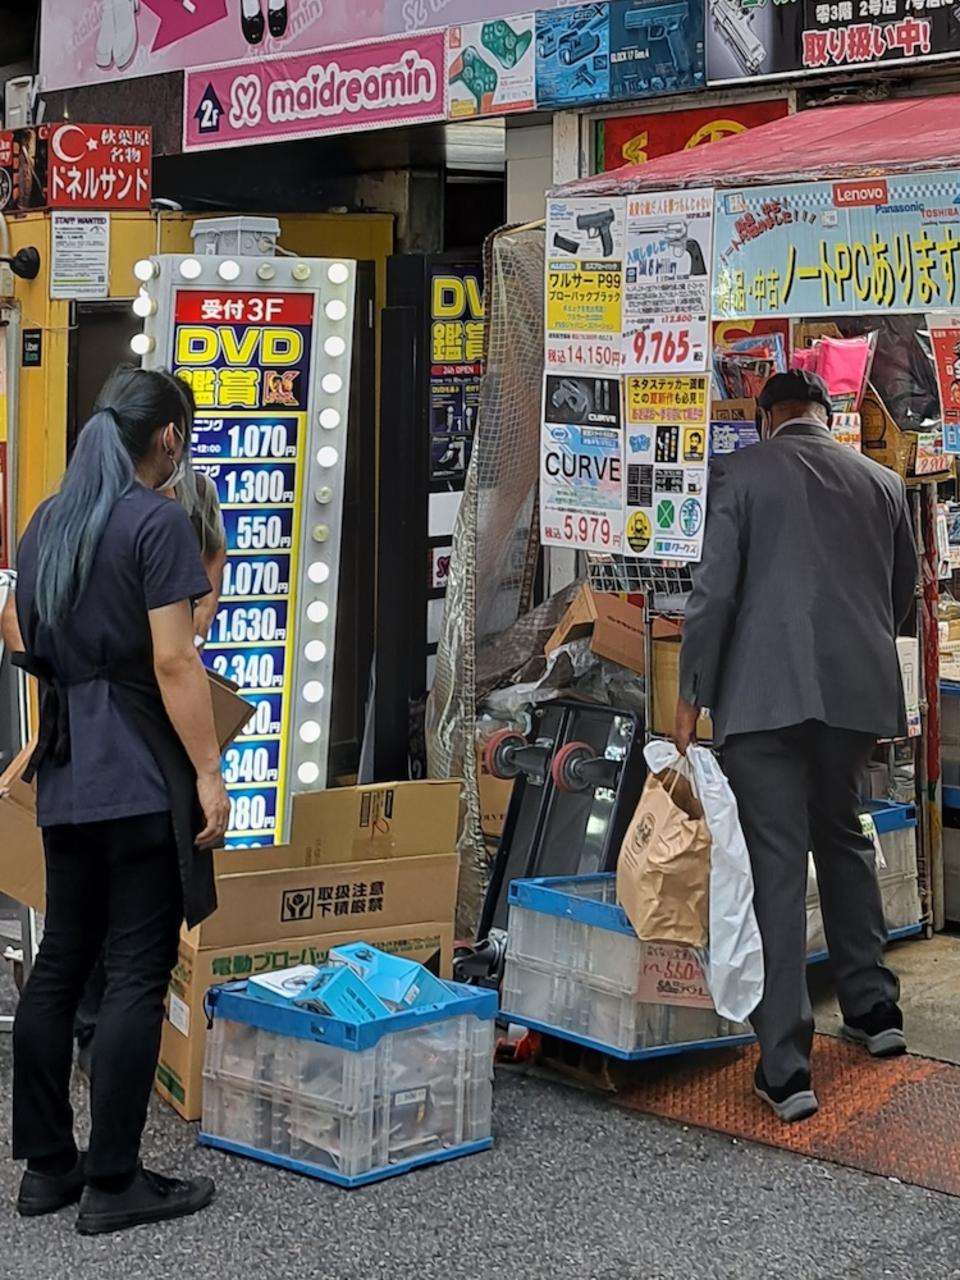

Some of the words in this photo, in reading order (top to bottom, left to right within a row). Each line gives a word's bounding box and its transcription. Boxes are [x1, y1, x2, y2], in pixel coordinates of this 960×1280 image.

[802, 17, 932, 67] 取り扱い中!
[270, 56, 433, 113] maidreamin
[100, 127, 151, 147] 秋葉原
[109, 147, 142, 164] 名物
[51, 165, 150, 202] ドネルサンド
[836, 186, 884, 203] Lenovo
[875, 202, 926, 216] Panasonic
[921, 207, 960, 220] TOSHIBA
[549, 273, 594, 290] ワルサー
[597, 273, 622, 289] P99
[549, 291, 621, 303] ブローバックブラック
[432, 276, 485, 320] DV
[24, 341, 39, 351] Uber
[176, 326, 304, 365] DVD
[587, 413, 617, 424] CURVE
[227, 424, 297, 458] 1,070円
[545, 451, 621, 483] CURVE
[225, 470, 295, 503] 1,300円
[236, 515, 292, 549] 550円
[221, 561, 289, 596] 1,070円
[216, 607, 286, 642] 1,630円
[212, 653, 284, 689] 2340円
[221, 747, 278, 783] 340円
[317, 881, 385, 901] 取扱注意
[316, 897, 384, 919] 下積厳禁
[211, 946, 331, 977] 電動ブローバッ
